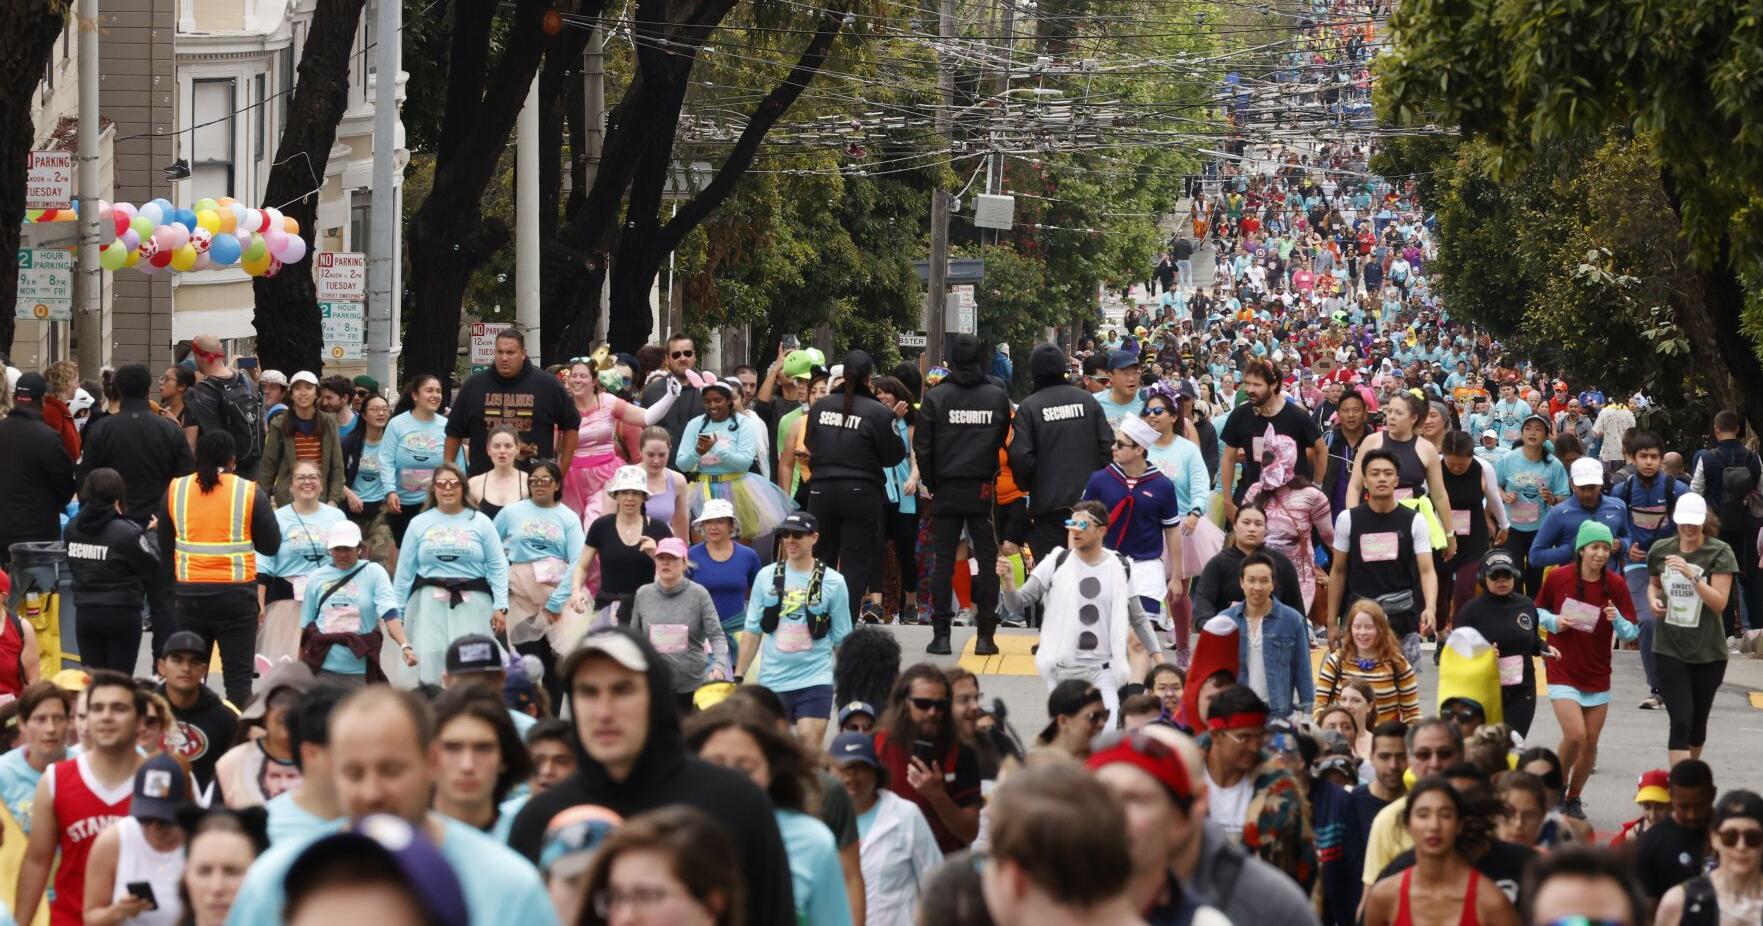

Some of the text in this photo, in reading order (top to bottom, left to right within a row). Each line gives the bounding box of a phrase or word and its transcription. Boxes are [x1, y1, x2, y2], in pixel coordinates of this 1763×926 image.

[35, 156, 70, 168] PARKING
[18, 251, 64, 267] 2 HOUR
[34, 261, 70, 270] PARKING
[320, 254, 363, 267] NO PARKING
[20, 287, 36, 295] MON
[54, 287, 66, 296] FRI
[326, 281, 357, 290] TUESDAY
[320, 304, 330, 317] 2
[332, 312, 362, 320] PARKING
[473, 324, 484, 336] NO
[479, 348, 497, 356] TUES
[485, 393, 503, 406] LOS
[949, 409, 993, 424] SECURITY
[1042, 403, 1085, 422] SECURITY
[818, 410, 862, 430] SECUITY
[68, 542, 109, 560] SECURITY
